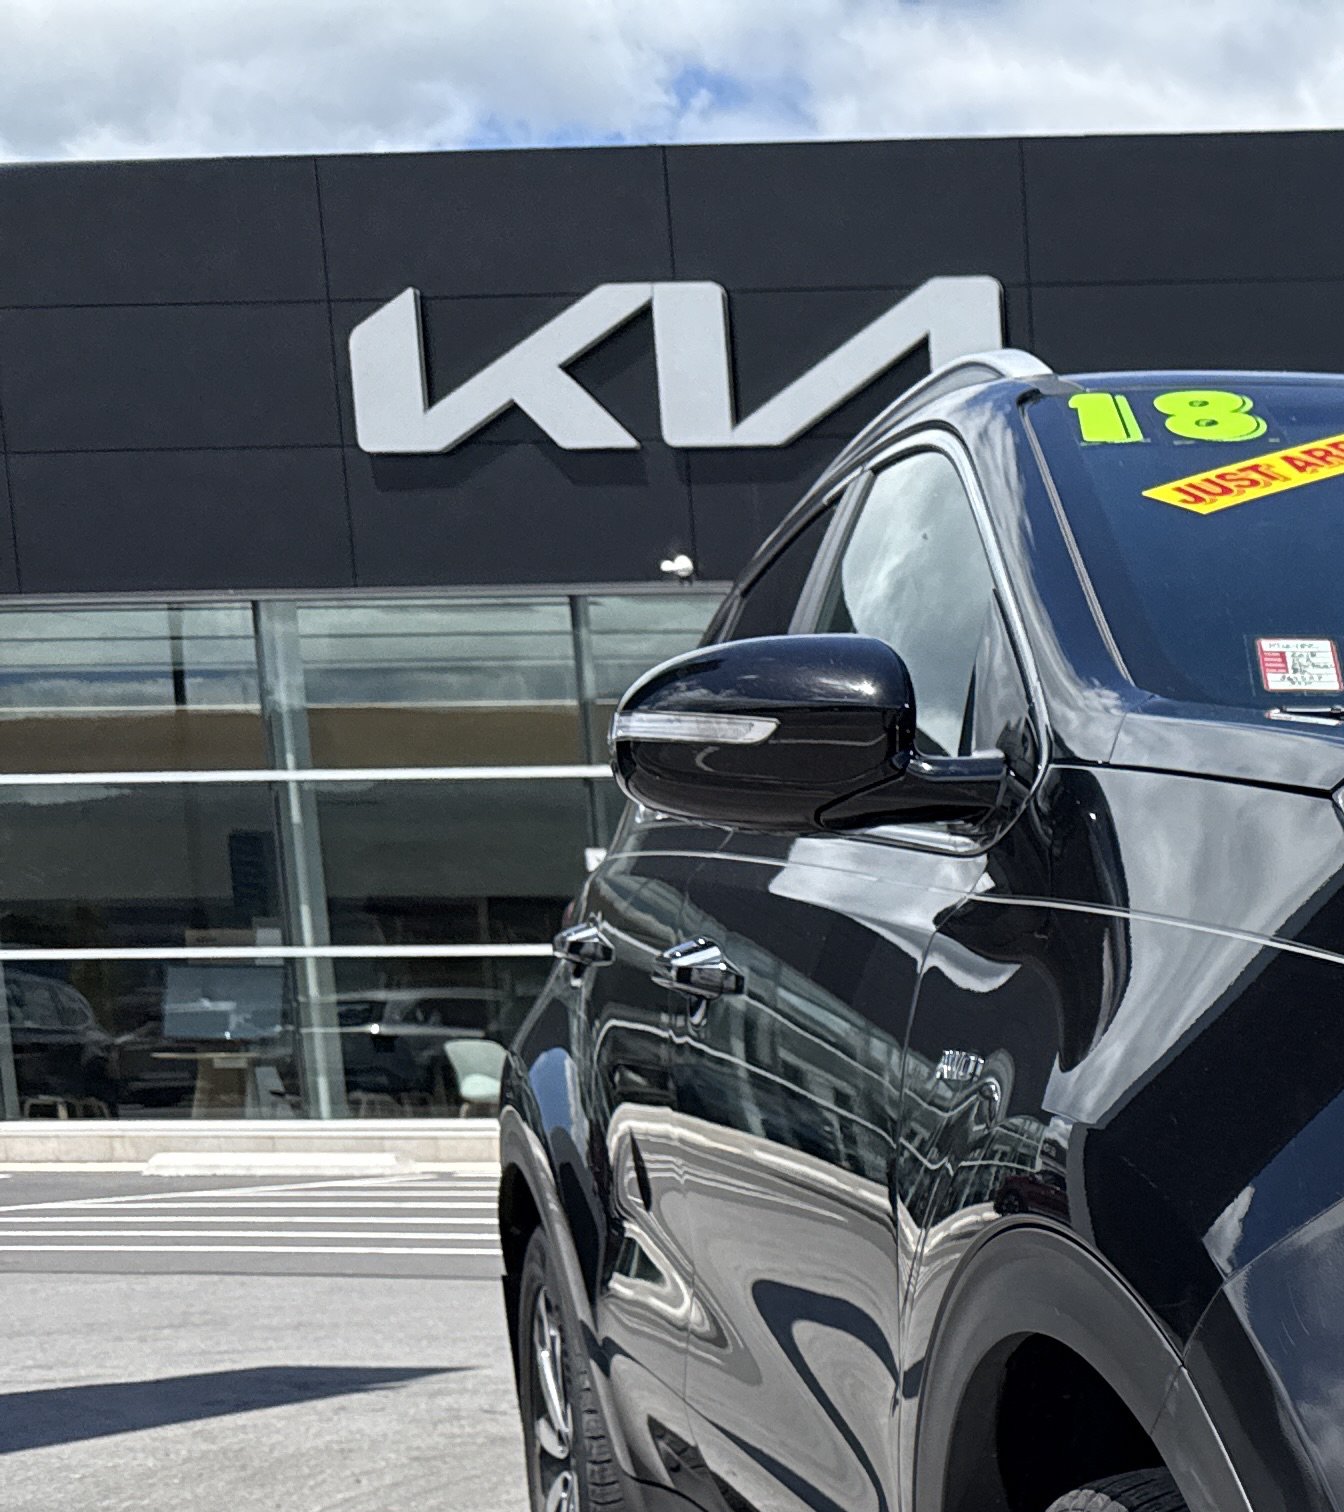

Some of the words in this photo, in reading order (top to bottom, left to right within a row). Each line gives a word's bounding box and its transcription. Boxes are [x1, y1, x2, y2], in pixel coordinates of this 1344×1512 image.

[349, 275, 1002, 453] KIA
[1069, 390, 1268, 442] 18
[1171, 463, 1290, 505] JUST
